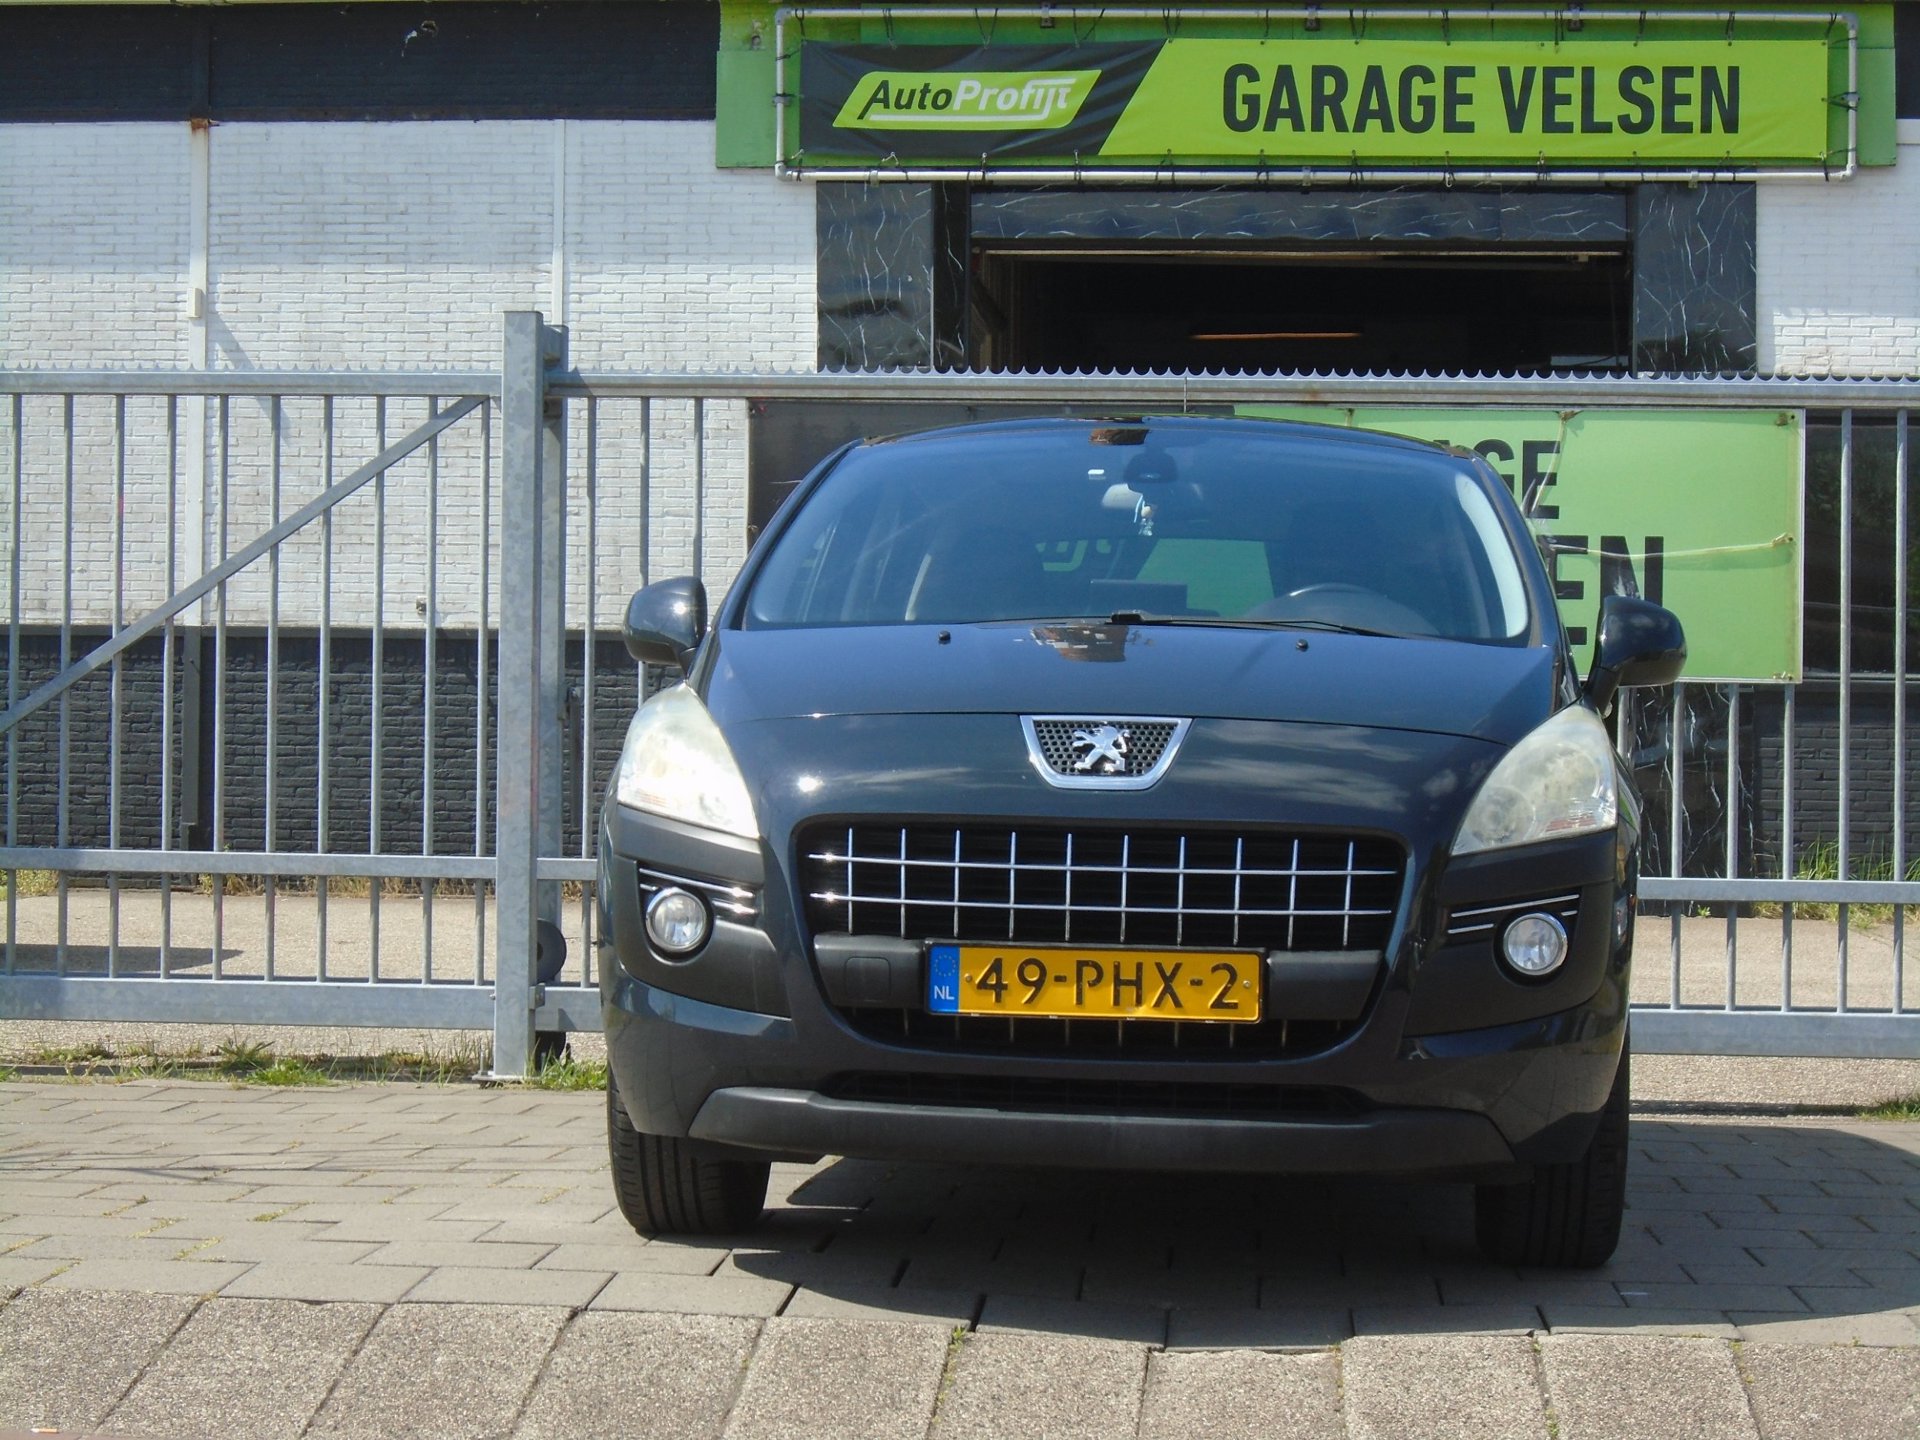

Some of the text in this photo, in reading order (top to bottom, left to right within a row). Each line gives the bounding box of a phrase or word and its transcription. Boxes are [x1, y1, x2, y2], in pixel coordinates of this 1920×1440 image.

[857, 78, 1077, 121] AutoProfijt
[1223, 63, 1740, 134] GARAGE VELSEN
[933, 986, 955, 1001] NL
[975, 957, 1240, 1010] 49-PHX-2
